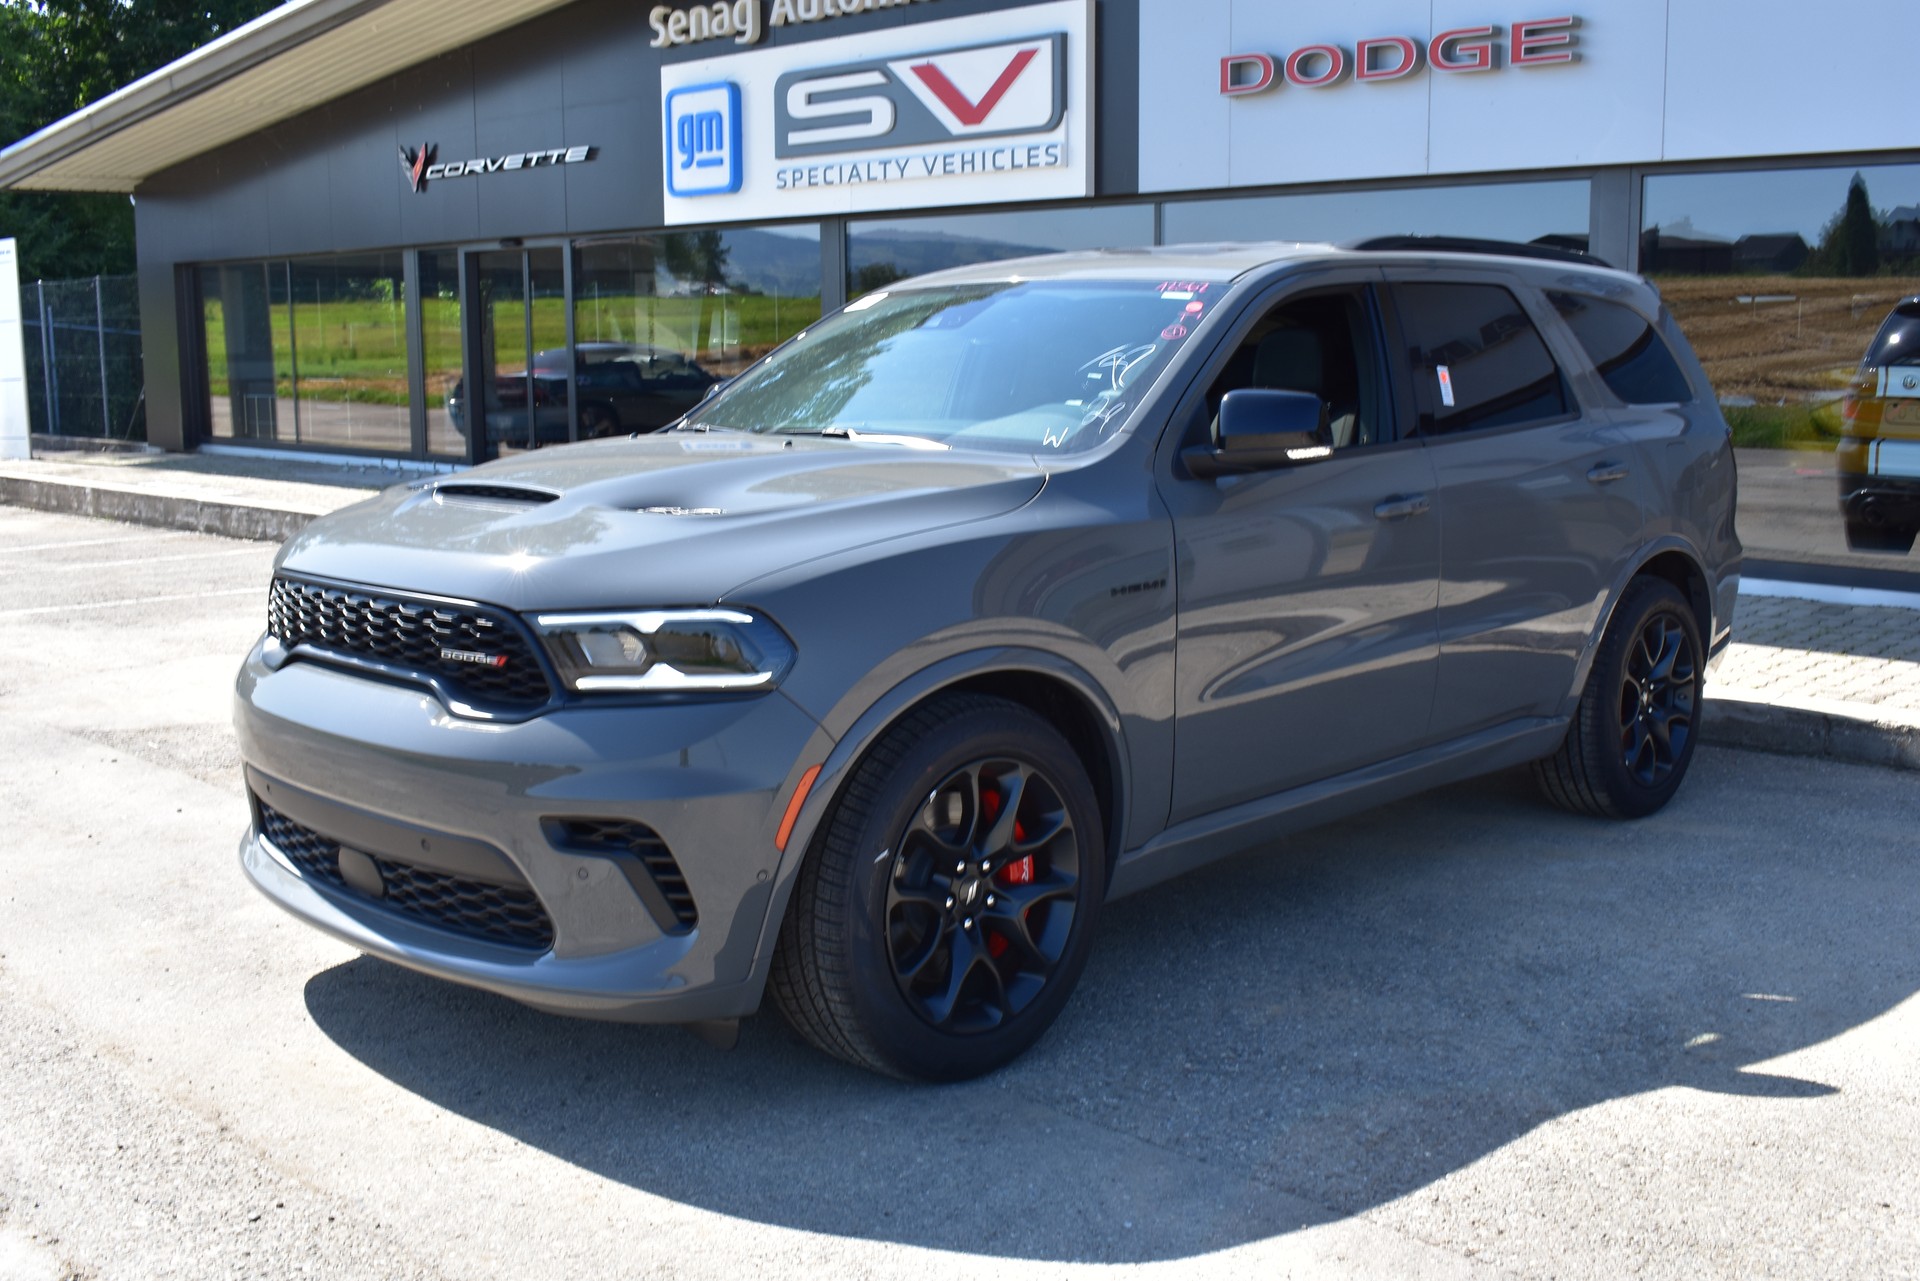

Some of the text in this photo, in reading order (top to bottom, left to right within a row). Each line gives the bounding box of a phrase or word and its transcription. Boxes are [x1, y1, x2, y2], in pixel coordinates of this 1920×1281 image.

[649, 1, 760, 48] Senag
[1220, 15, 1582, 96] DODGE
[786, 48, 1040, 145] SV
[426, 145, 590, 180] CORVETTE
[678, 111, 724, 170] gm
[776, 143, 1060, 190] SPECIALTY VEHICLES
